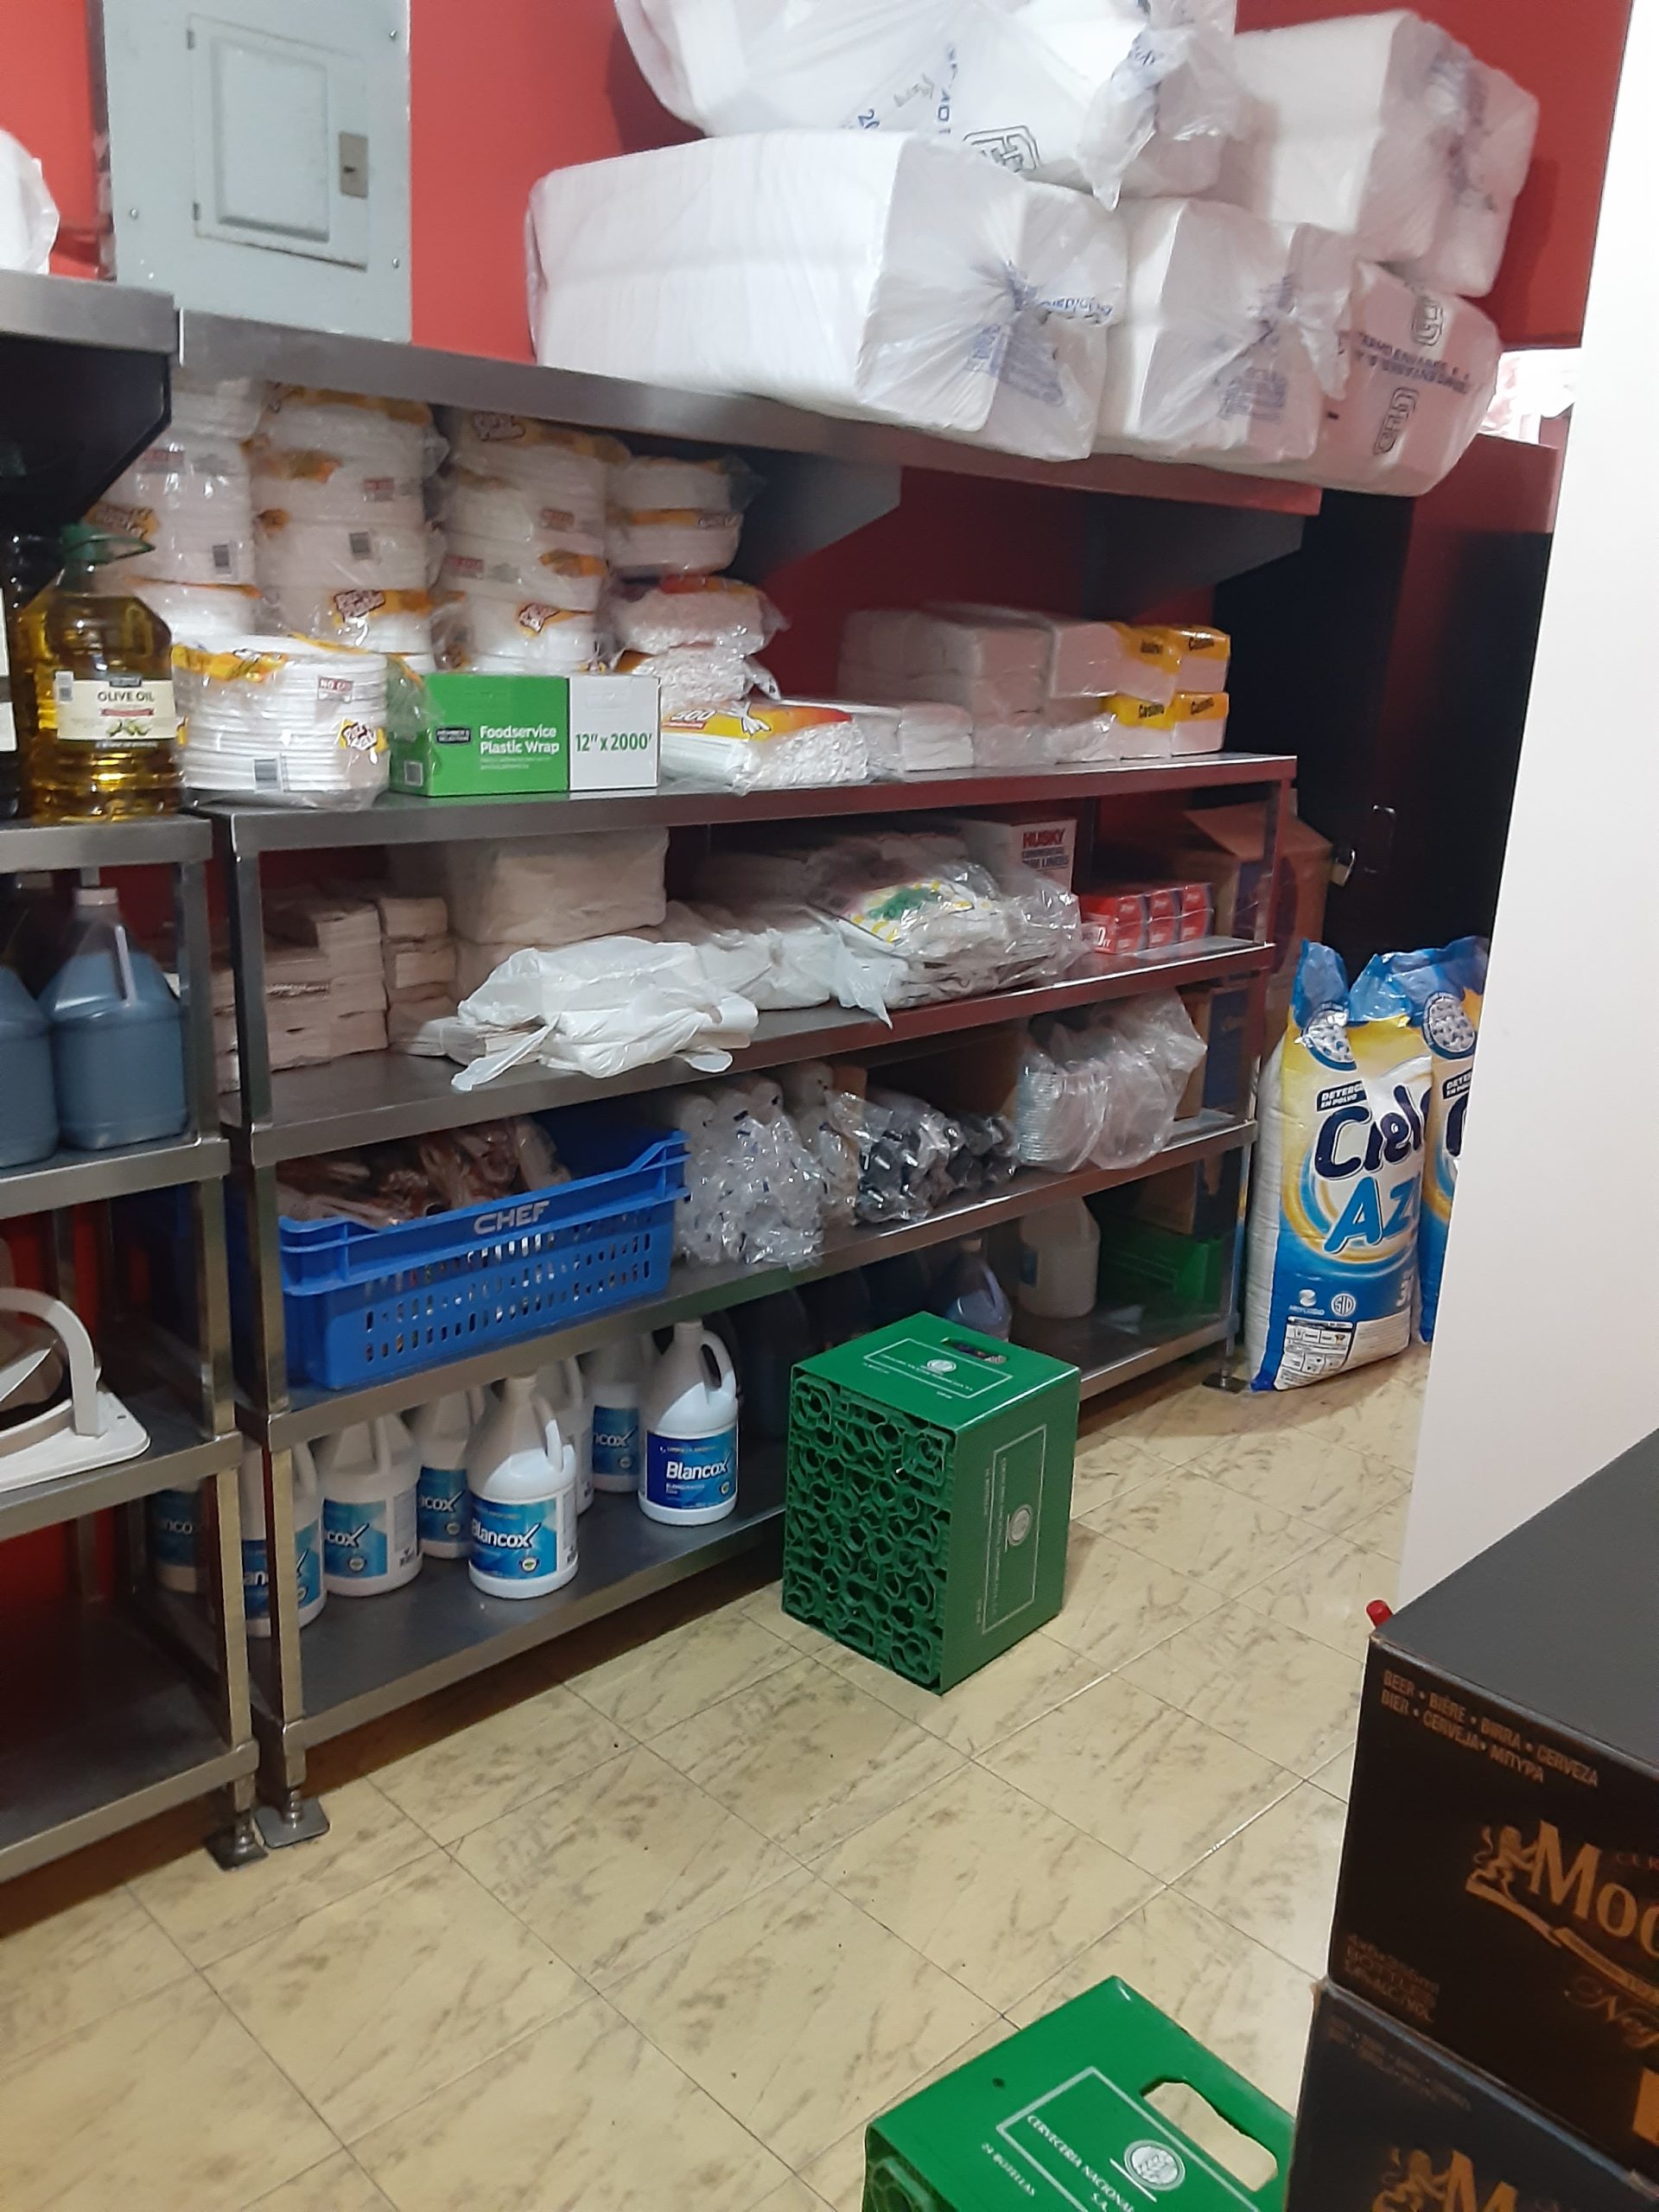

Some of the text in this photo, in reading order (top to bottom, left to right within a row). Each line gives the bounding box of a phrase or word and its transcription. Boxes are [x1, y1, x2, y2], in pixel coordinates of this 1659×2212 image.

[98, 691, 155, 702] OLIVE OIL
[480, 724, 557, 740] Foodservice
[600, 737, 608, 751] x
[480, 740, 560, 756] Plastic Wrap
[474, 1199, 550, 1235] CHEF
[666, 1449, 731, 1480] Blancox
[472, 1518, 542, 1548] Blancox
[1382, 1669, 1414, 1697] BEER
[1536, 1744, 1598, 1788] CERVEZA
[1027, 2114, 1083, 2168] CERVECERIA
